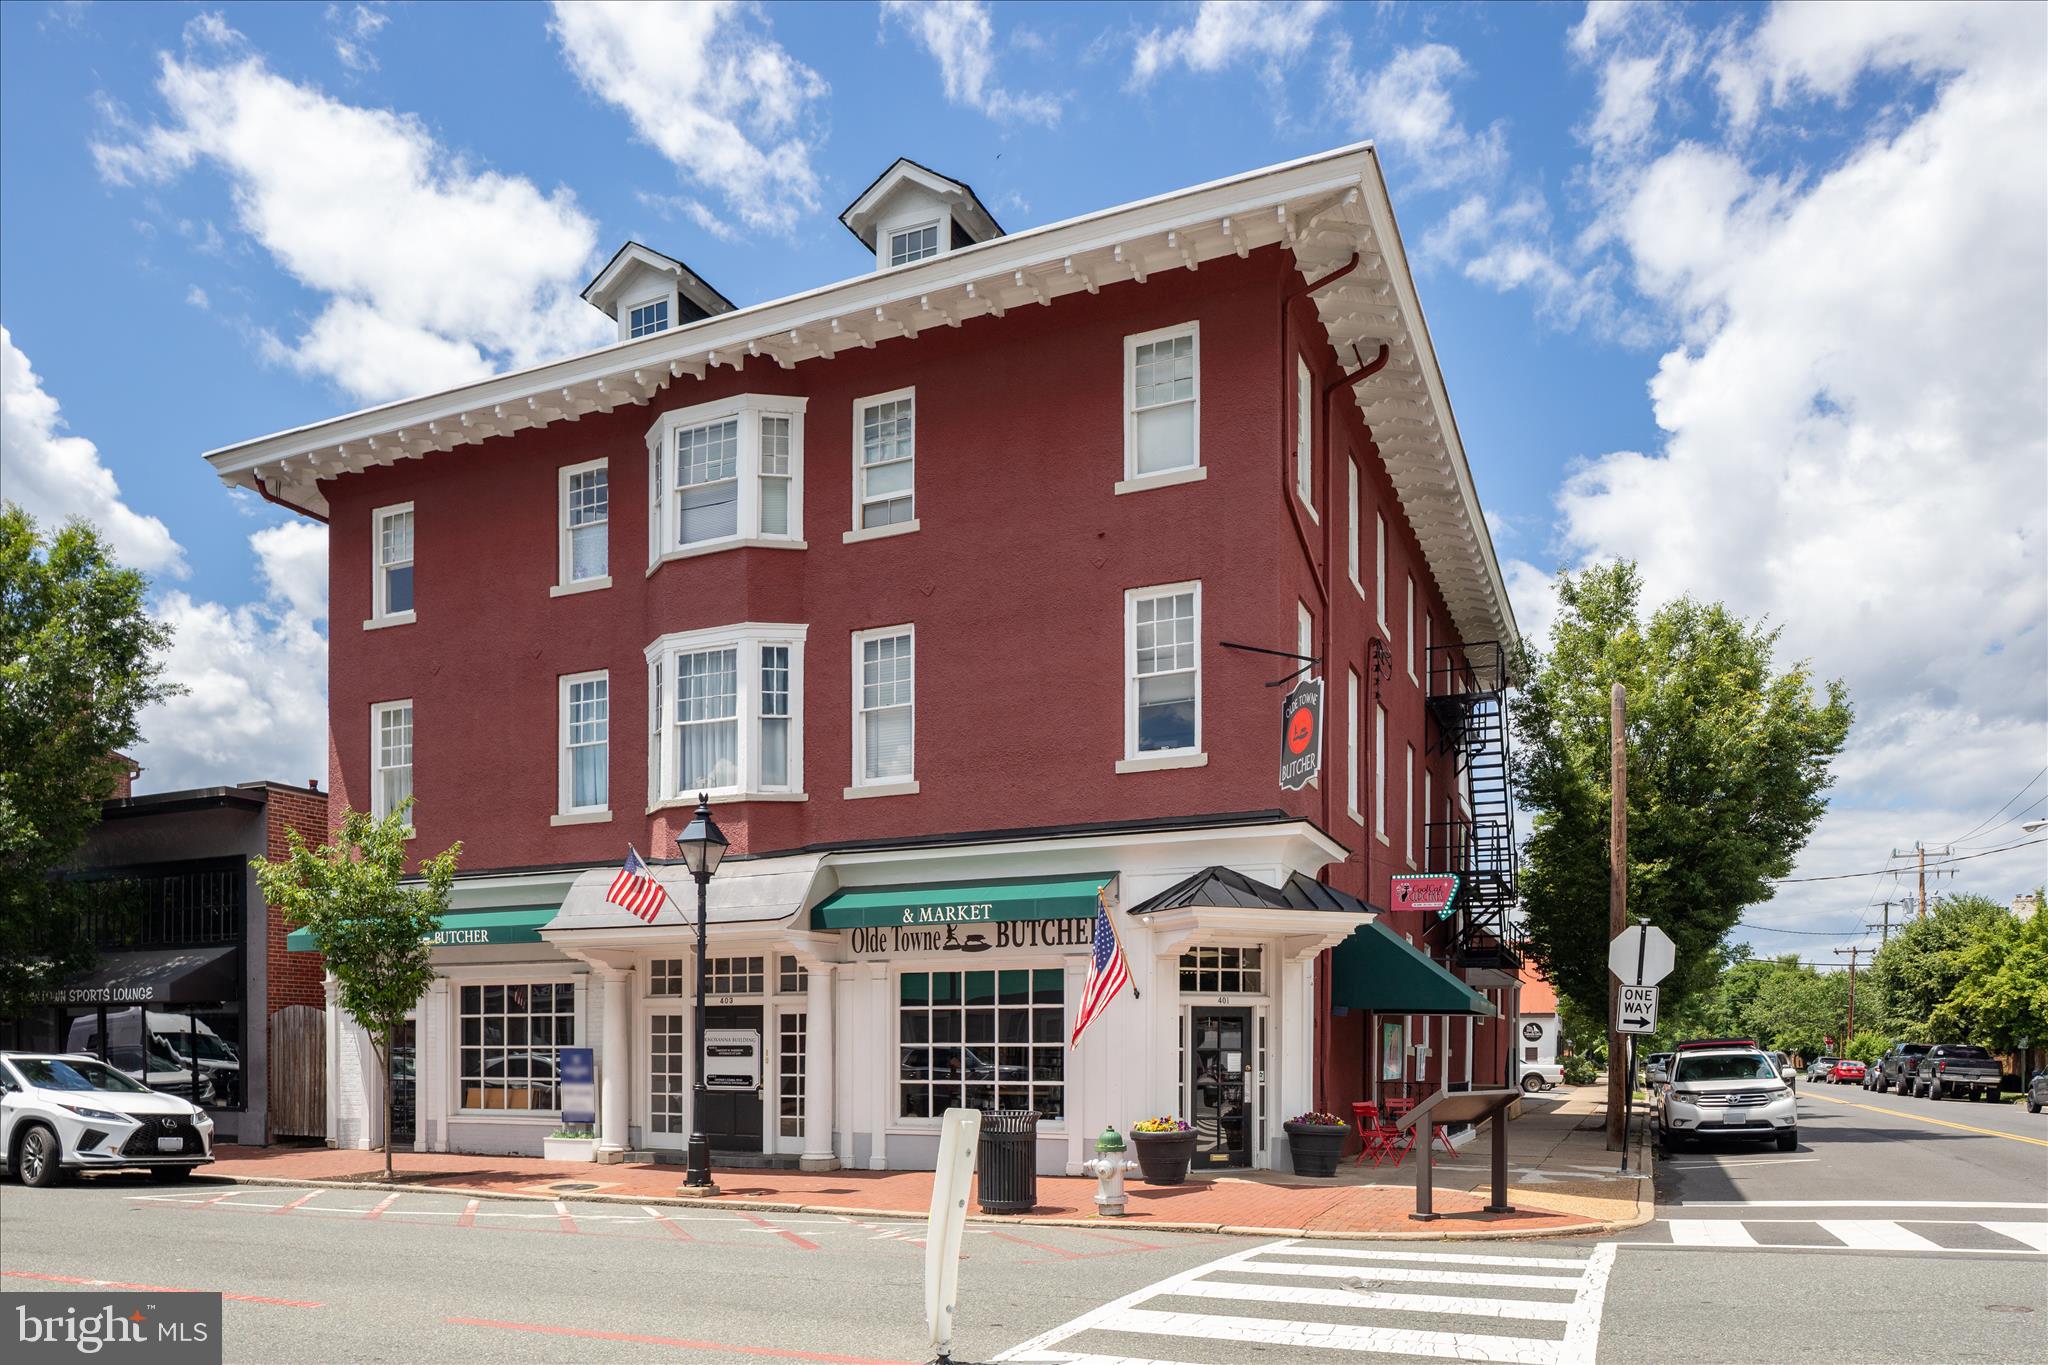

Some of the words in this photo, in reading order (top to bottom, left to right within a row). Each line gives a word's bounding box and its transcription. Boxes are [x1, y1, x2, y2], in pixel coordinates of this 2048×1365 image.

[1286, 700, 1298, 719] OLDE
[1299, 693, 1318, 706] TOWNE
[1281, 752, 1316, 782] BUTCHER
[902, 908, 914, 923] &
[919, 904, 993, 923] MARKET
[434, 929, 489, 944] BUTCHER
[851, 927, 887, 954] Olde
[891, 926, 941, 952] Towne
[69, 988, 111, 1002] SPORTS
[113, 986, 154, 1001] LOUNGE
[1531, 1026, 1555, 1037] ONE
[1531, 1037, 1555, 1048] WAY
